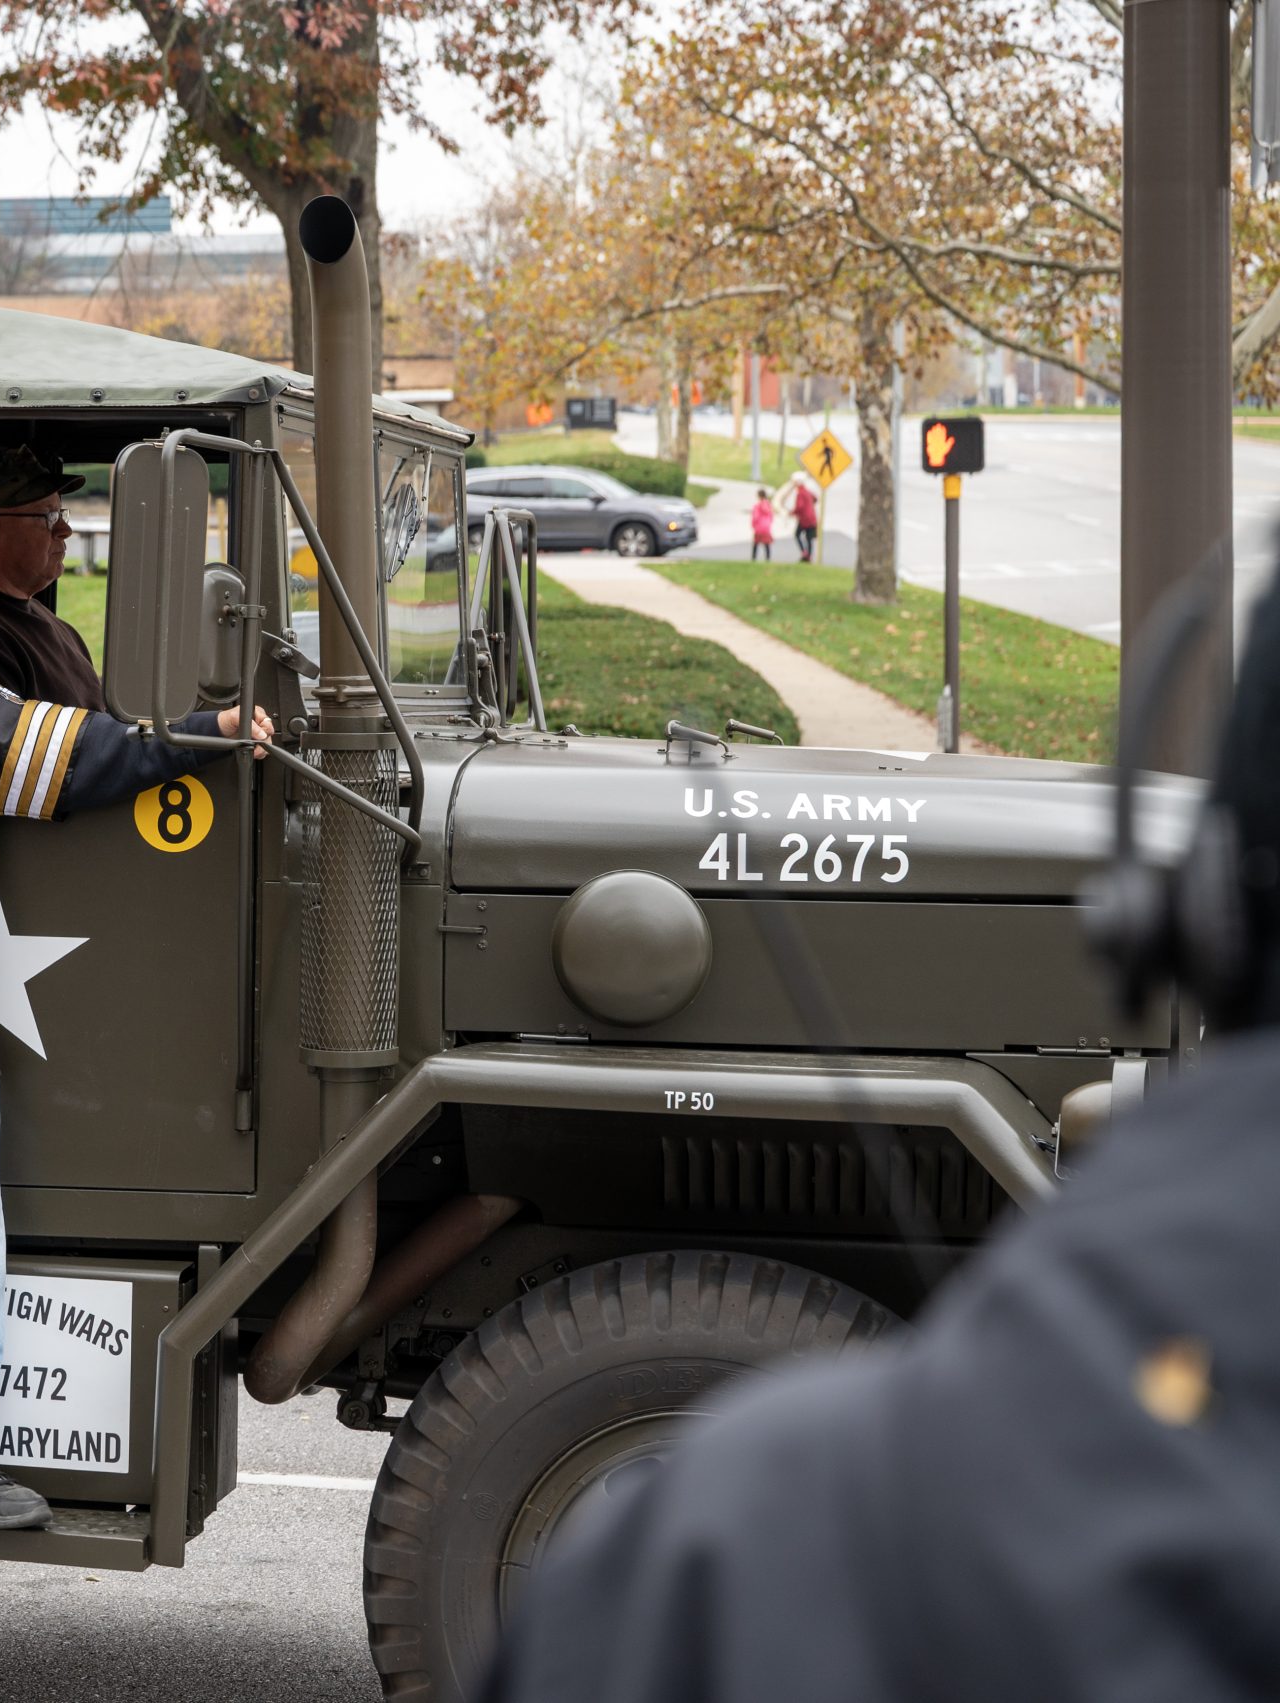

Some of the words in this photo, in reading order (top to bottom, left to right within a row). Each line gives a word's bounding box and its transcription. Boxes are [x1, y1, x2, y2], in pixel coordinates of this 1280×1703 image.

[158, 780, 192, 844] 8
[684, 788, 771, 819] U.S.
[786, 793, 927, 822] ARMY
[698, 832, 763, 881] 4L
[779, 833, 909, 883] 2675
[664, 1090, 686, 1109] TP
[690, 1092, 714, 1111] 50
[58, 1302, 129, 1356] WARS
[0, 1364, 67, 1401] 7472
